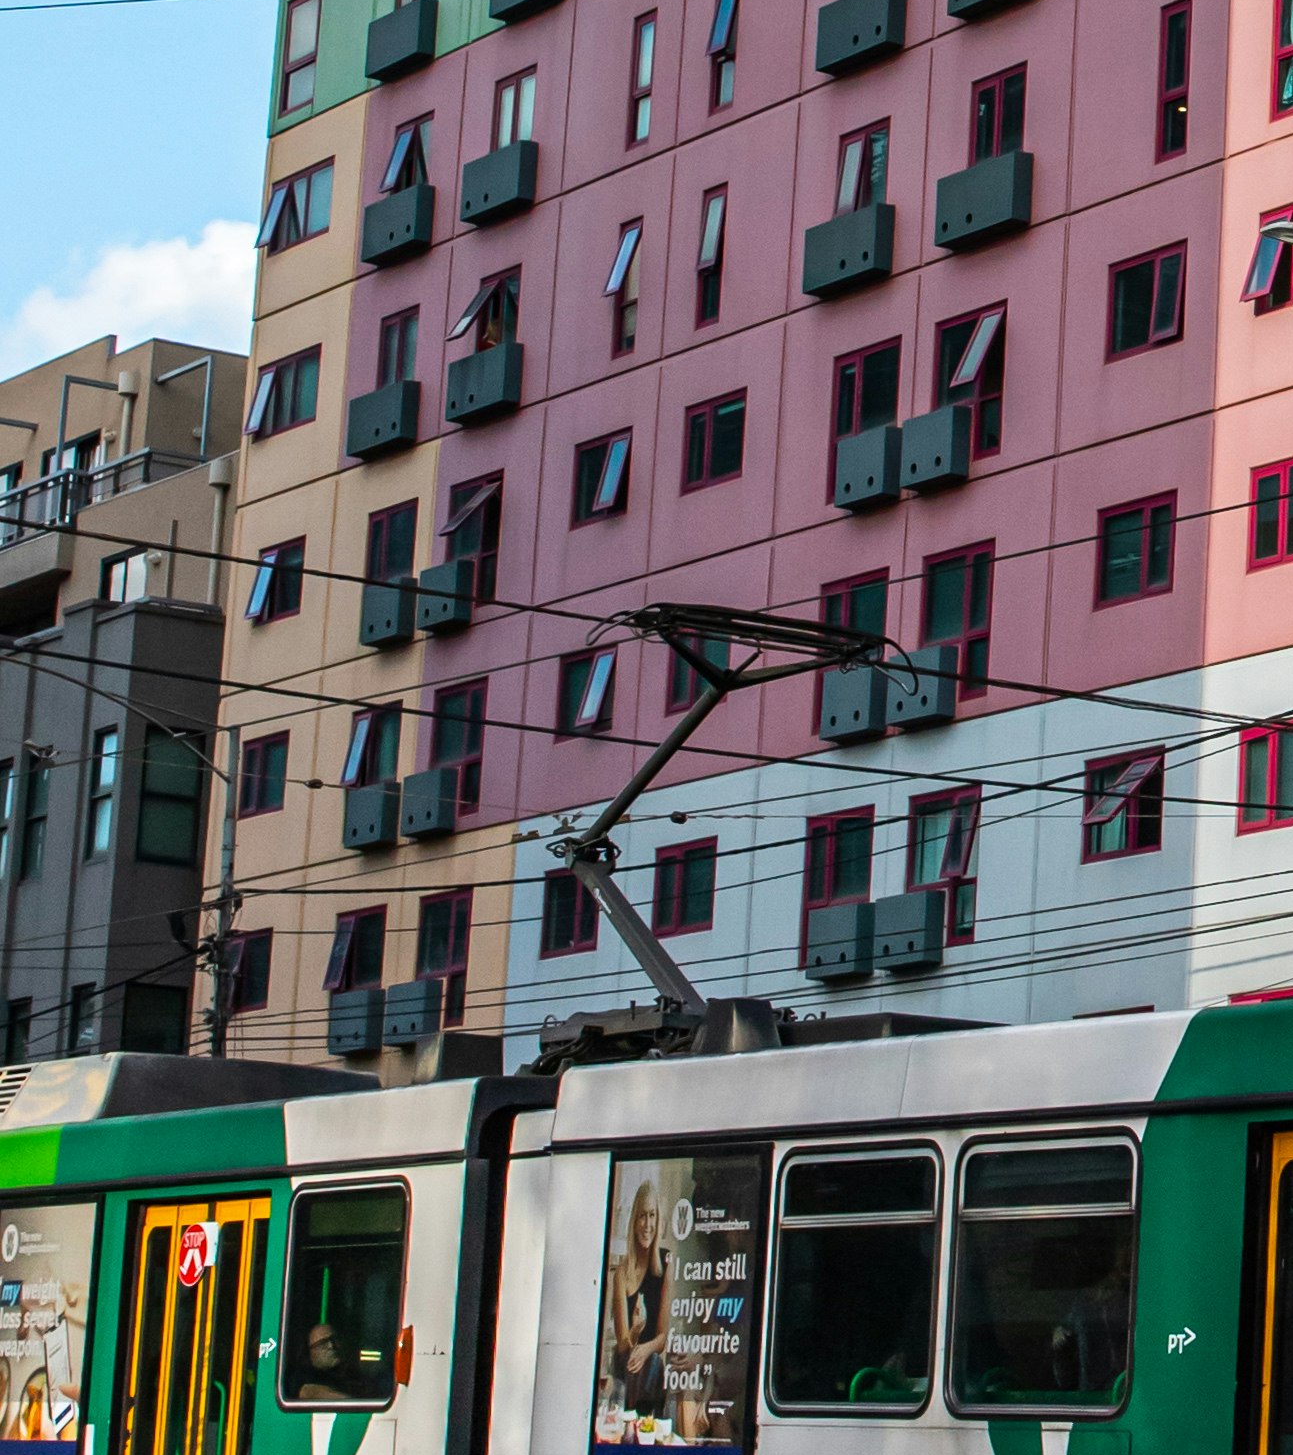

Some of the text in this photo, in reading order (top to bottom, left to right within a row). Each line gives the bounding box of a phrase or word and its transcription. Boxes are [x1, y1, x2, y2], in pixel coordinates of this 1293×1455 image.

[184, 1231, 205, 1249] STOP
[683, 1261, 712, 1281] can
[715, 1253, 747, 1280] still
[670, 1291, 744, 1324] enjoy my
[666, 1327, 740, 1356] favourite
